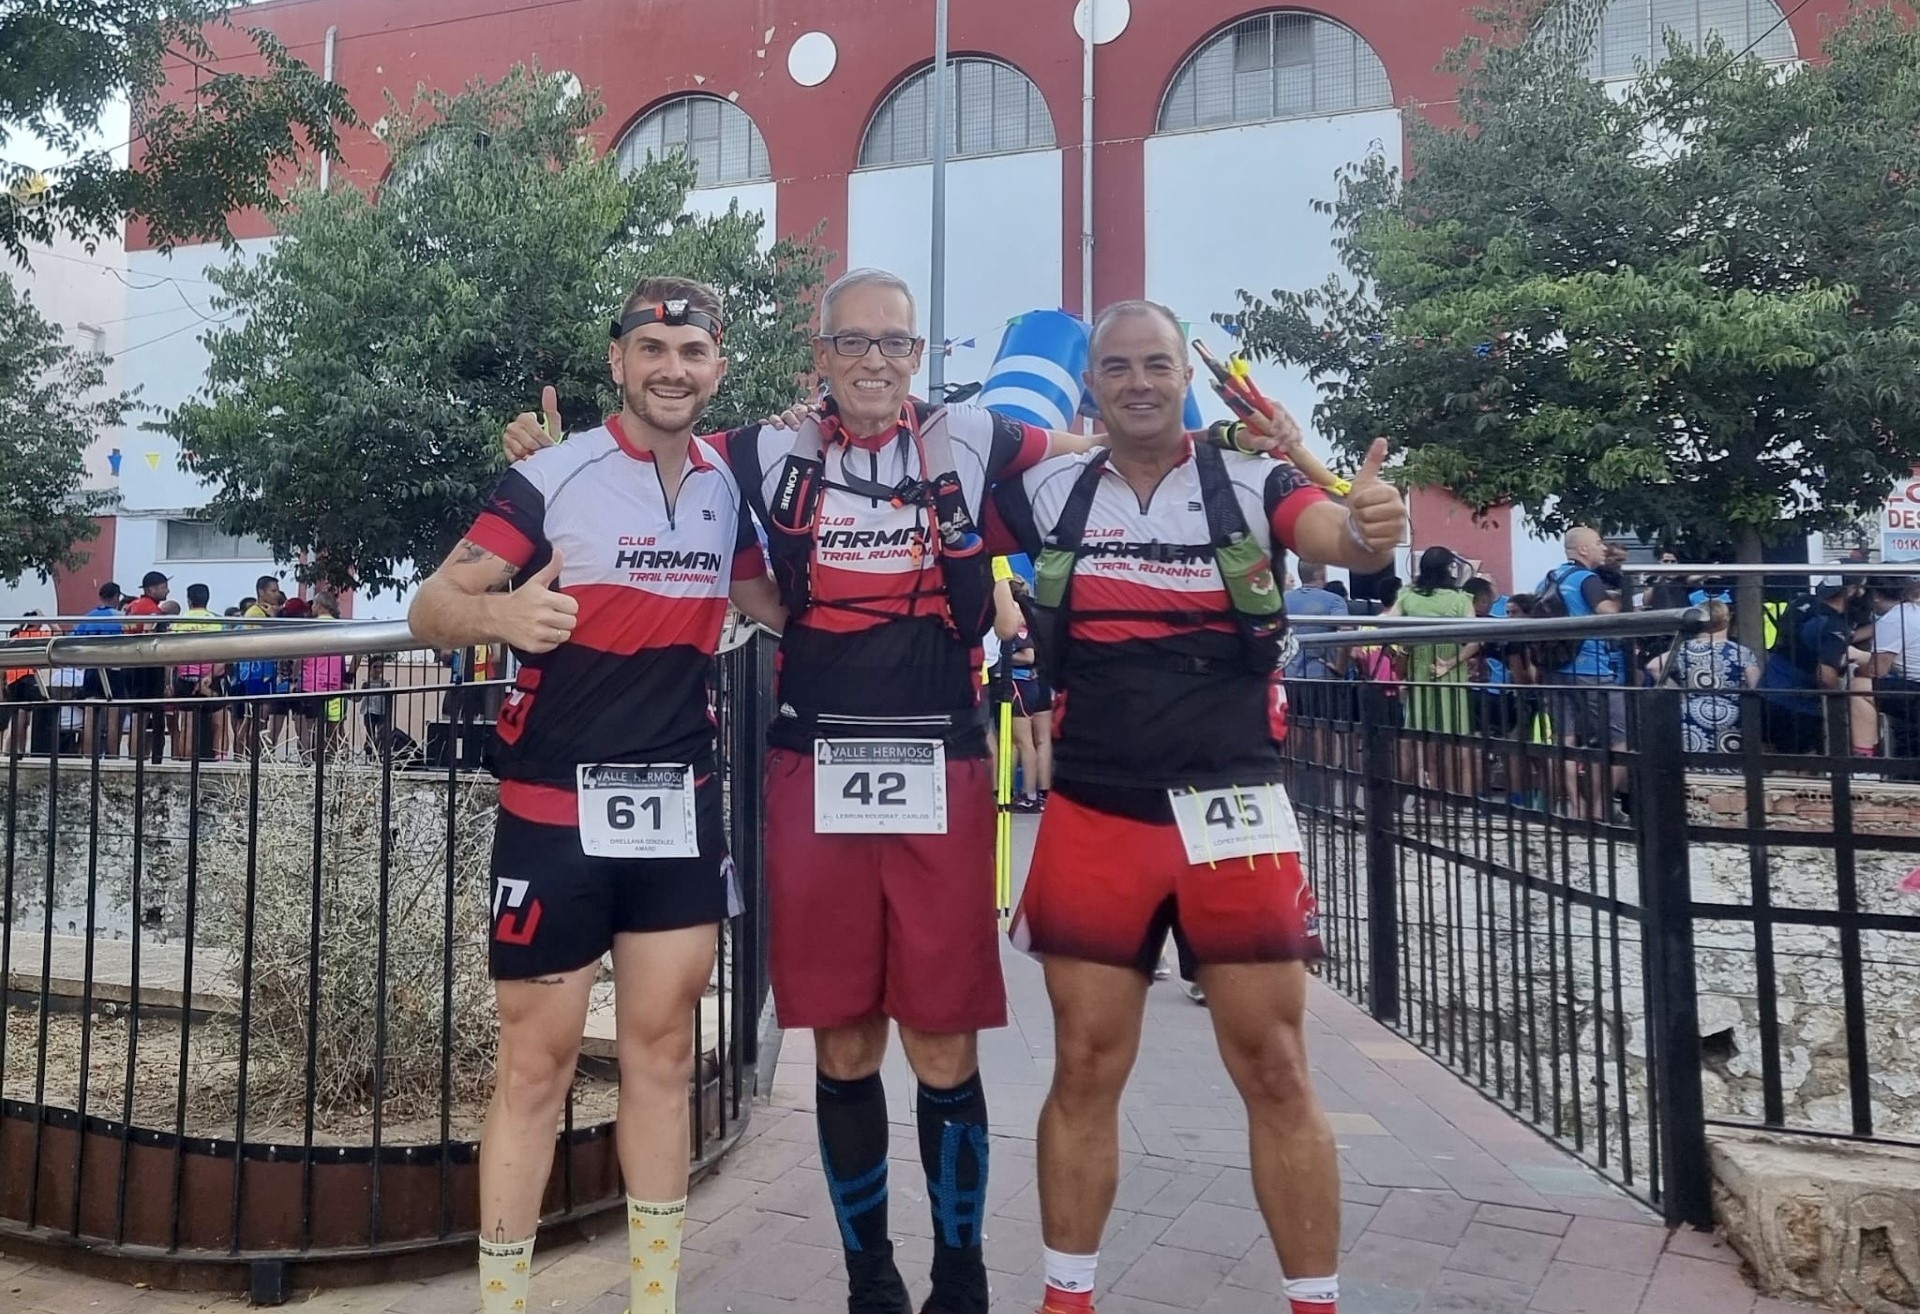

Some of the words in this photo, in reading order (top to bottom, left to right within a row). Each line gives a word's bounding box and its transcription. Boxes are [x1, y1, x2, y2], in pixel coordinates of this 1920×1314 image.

[1888, 509, 1920, 529] DE
[1083, 528, 1125, 538] CLUB
[618, 536, 656, 546] CLUB
[1891, 539, 1920, 550] 101K
[615, 550, 722, 572] HARMAN
[821, 551, 865, 561] TRAIL
[1093, 562, 1134, 571] TRAIL
[1139, 563, 1213, 578] RUNNING
[628, 572, 662, 582] TRAIL
[664, 572, 718, 585] RUNNING
[832, 747, 867, 758] VALLE
[634, 771, 683, 783] HRMOSO
[843, 772, 907, 806] 42
[607, 795, 662, 831] 61
[1205, 793, 1265, 831] 45
